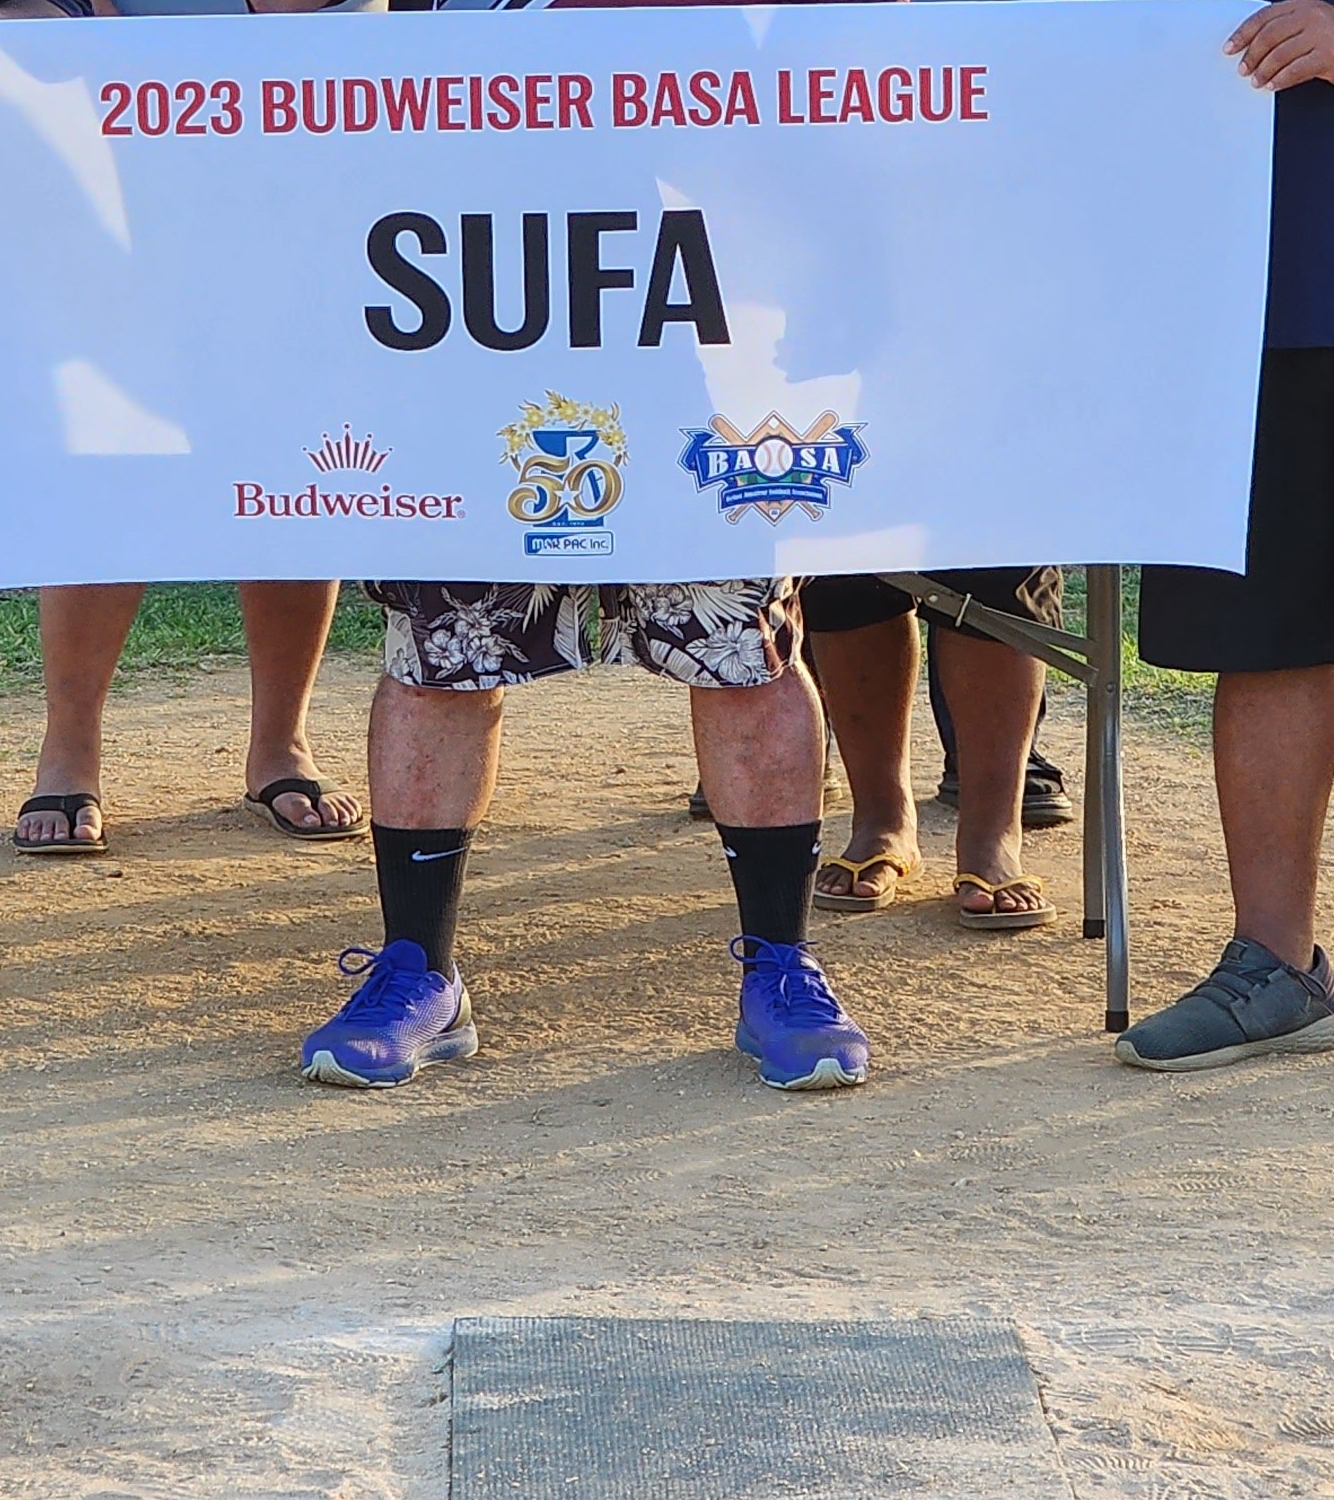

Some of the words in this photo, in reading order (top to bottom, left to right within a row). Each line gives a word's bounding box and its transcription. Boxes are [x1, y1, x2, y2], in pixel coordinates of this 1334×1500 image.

[100, 80, 243, 136] 2023
[261, 74, 594, 134] BUDWEISER
[611, 71, 761, 129] BASA
[777, 66, 988, 124] LEAGUE
[364, 209, 732, 352] SUFA
[233, 483, 463, 519] Budweiser
[507, 455, 624, 522] 50
[563, 537, 587, 550] PAC
